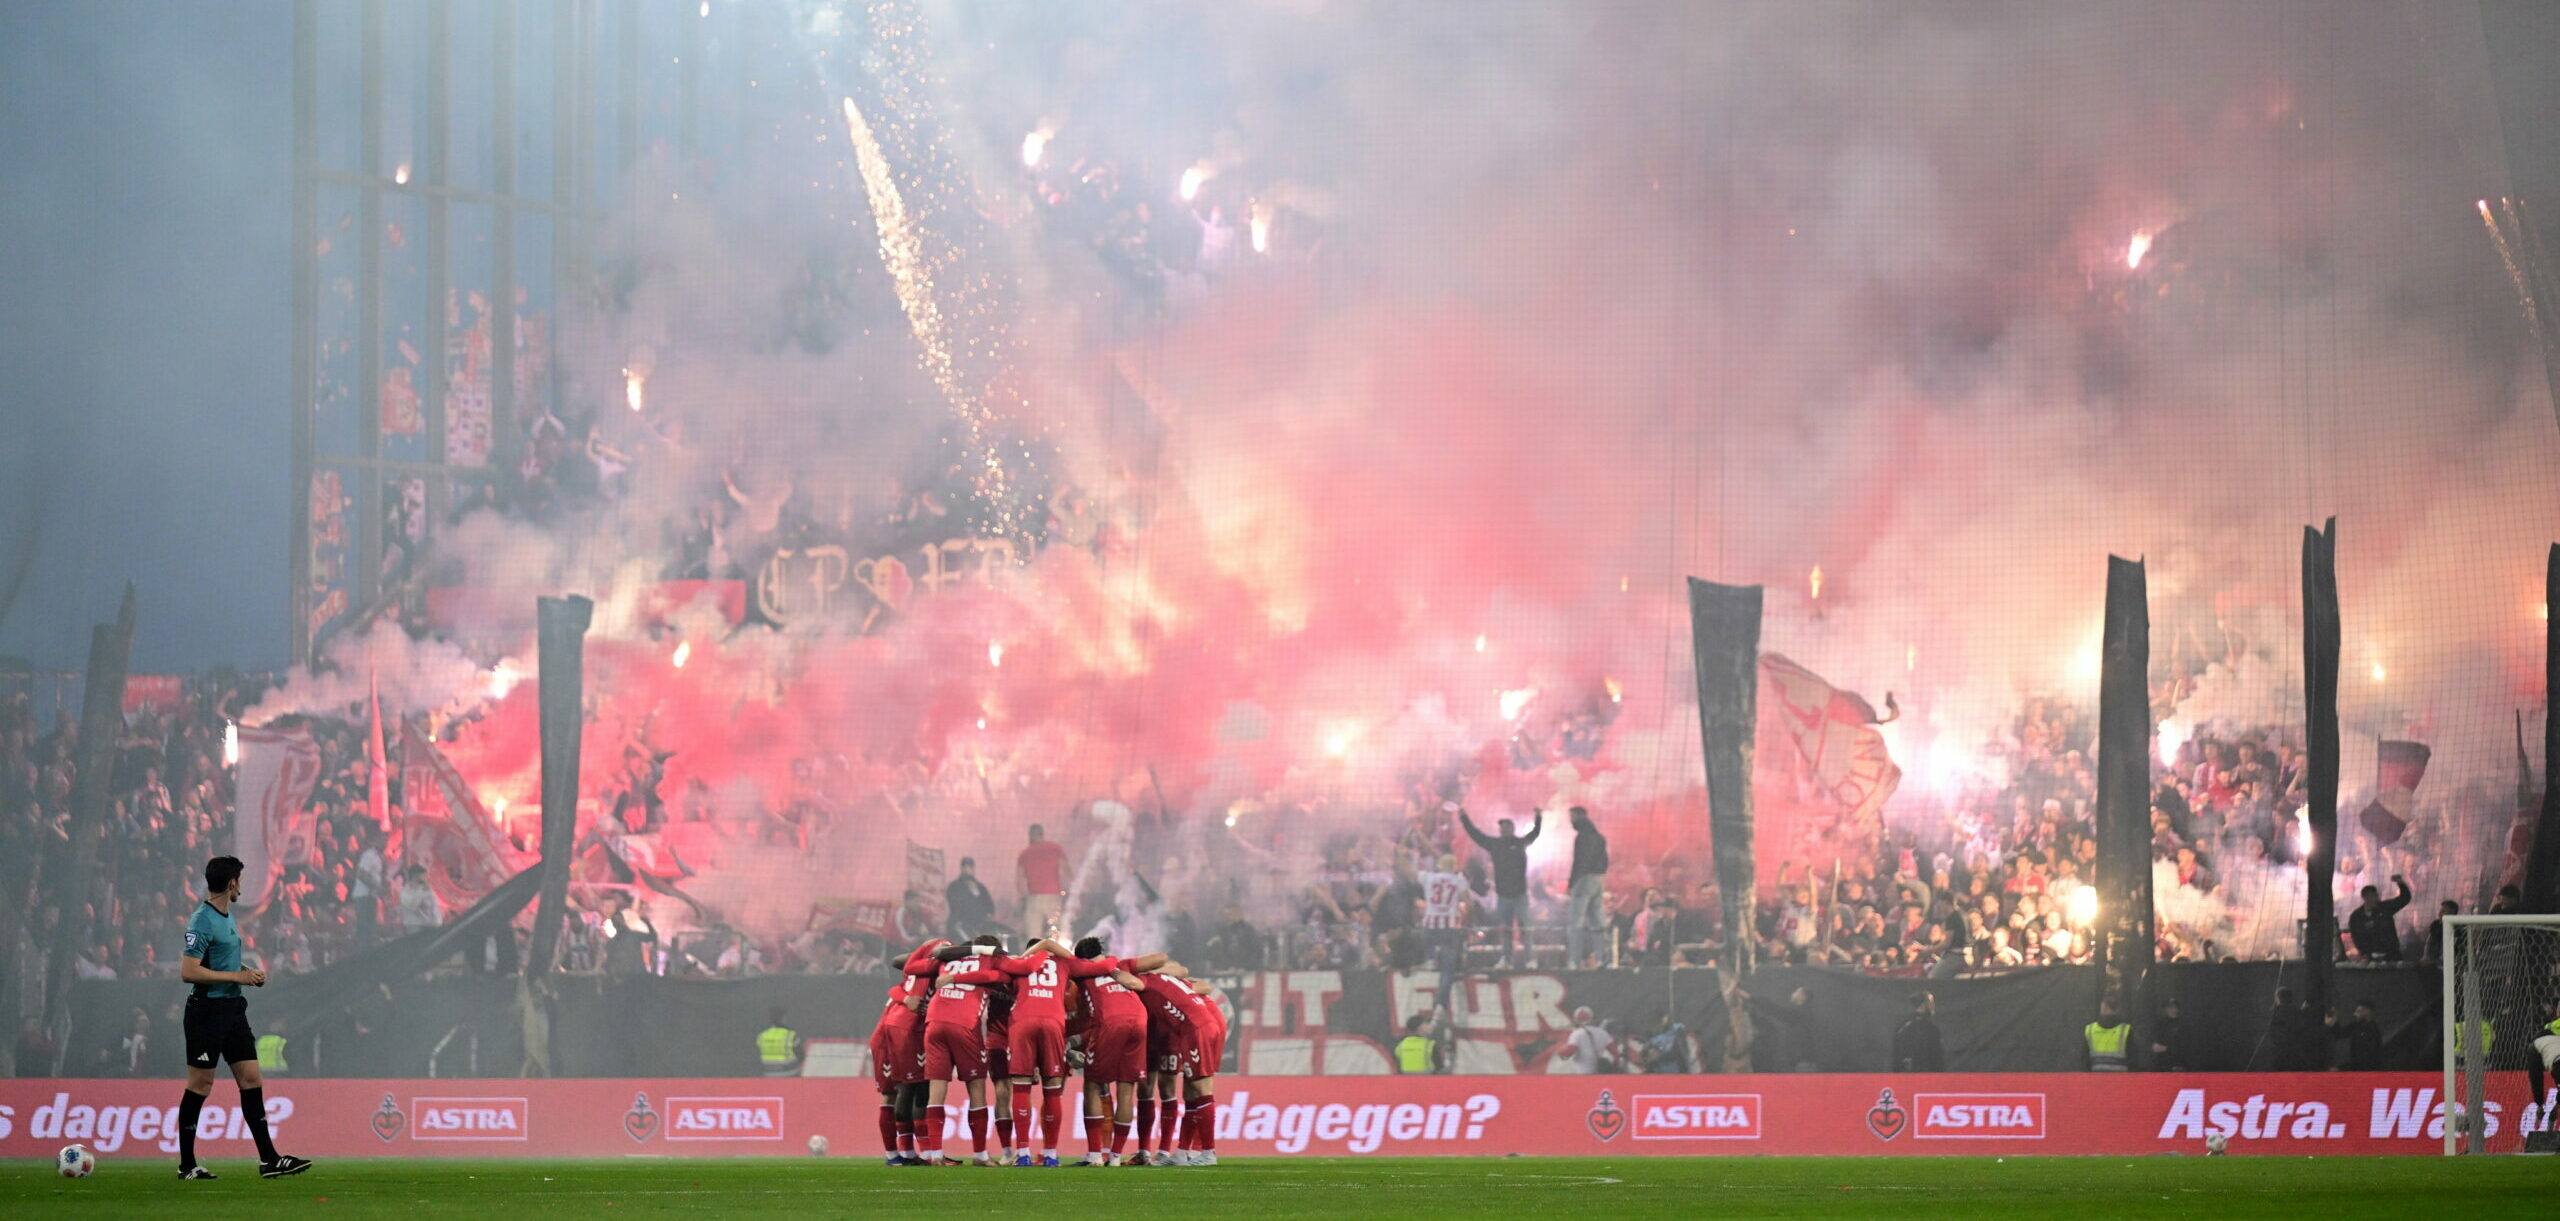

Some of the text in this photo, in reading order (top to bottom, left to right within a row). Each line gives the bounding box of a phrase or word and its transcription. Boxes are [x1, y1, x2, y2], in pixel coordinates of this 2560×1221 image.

[1431, 882, 1457, 905] 37
[1161, 1054, 1178, 1071] 39
[30, 1092, 295, 1153] dagegen?
[421, 1108, 518, 1130] ASTRA
[674, 1108, 774, 1130] ASTRA
[1213, 1091, 1500, 1154] dagegen?
[1643, 1105, 1750, 1128] ASTRA
[1924, 1104, 2034, 1128] ASTRA
[2157, 1087, 2346, 1140] Astra.
